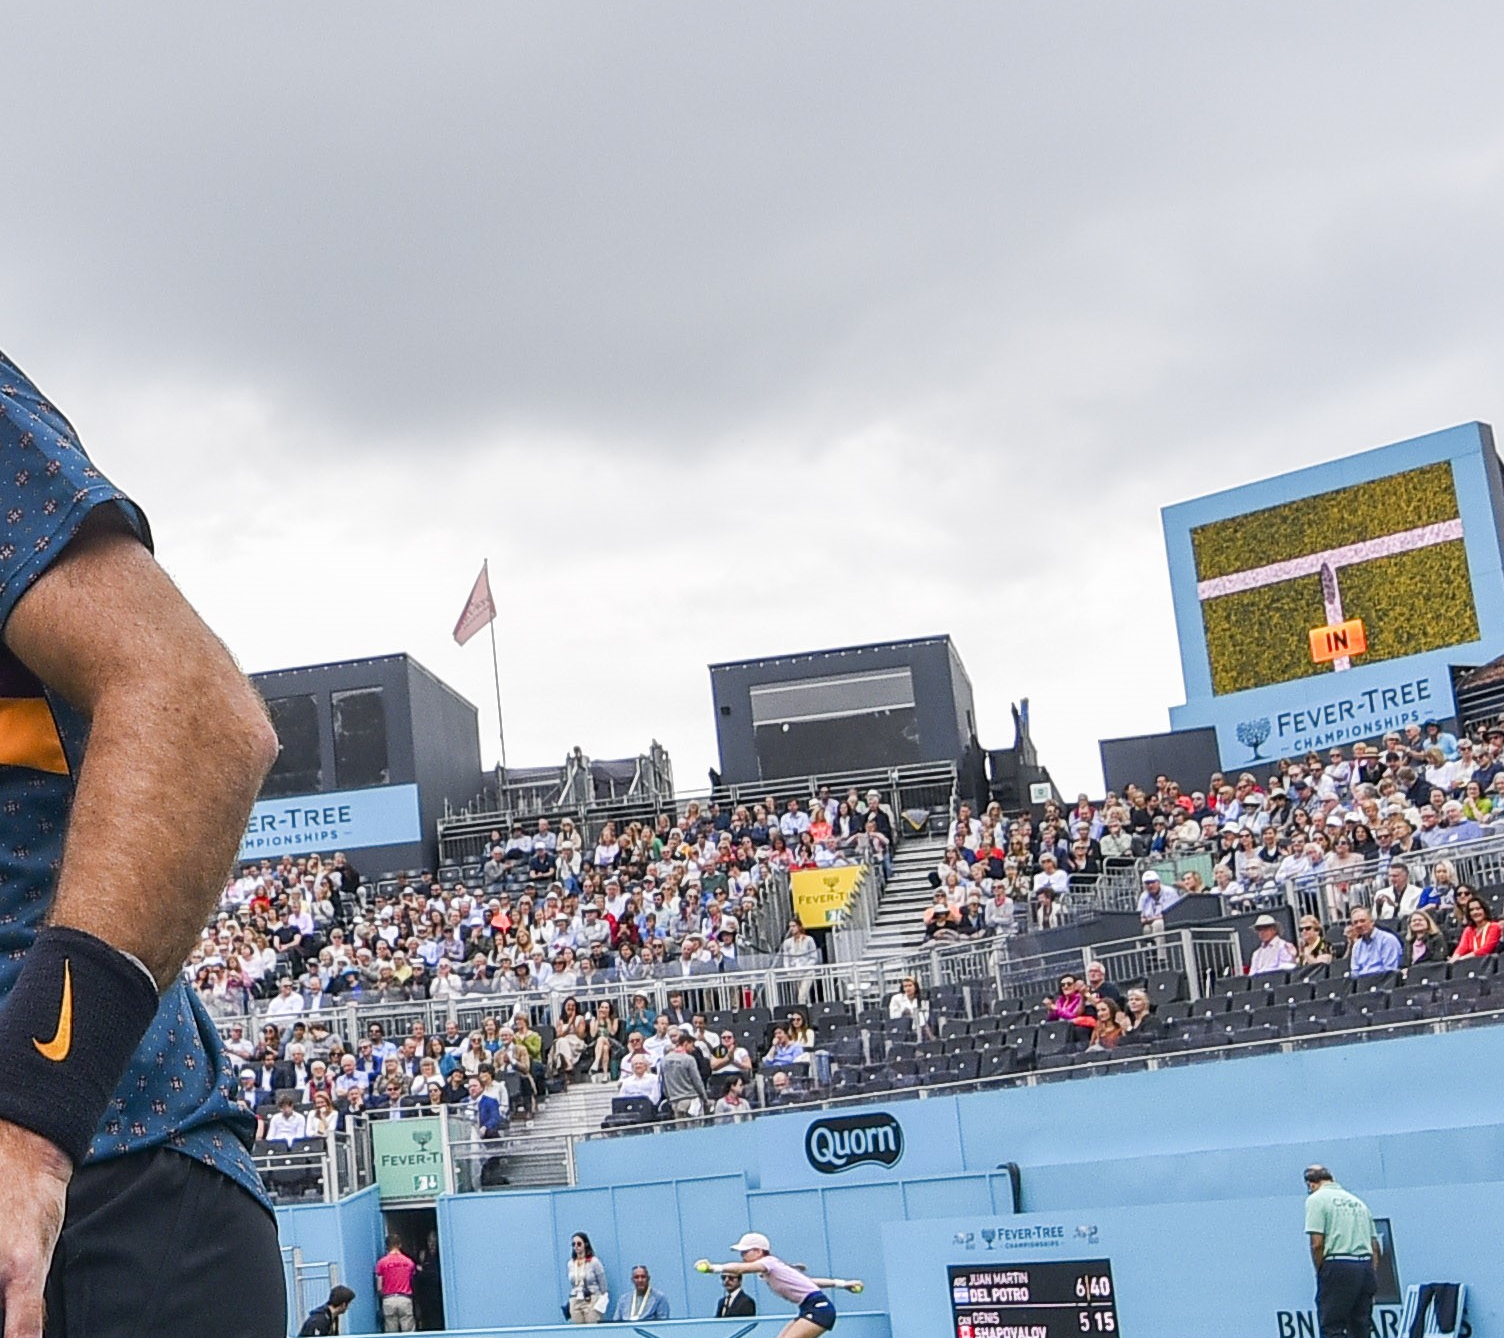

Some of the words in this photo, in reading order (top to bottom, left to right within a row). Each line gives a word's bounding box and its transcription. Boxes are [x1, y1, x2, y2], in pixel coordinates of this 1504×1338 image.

[1326, 630, 1349, 653] IN
[1277, 678, 1432, 738] FEVER-TREE
[1294, 710, 1420, 752] CHAMPIONSHIPS
[798, 891, 850, 905] FEVER-T
[811, 1125, 897, 1166] Quorn
[997, 1225, 1065, 1241] FEVER-TREE
[969, 1273, 992, 1286] JUAN
[993, 1271, 1029, 1285] MARTIN
[1075, 1278, 1085, 1297] 6
[1090, 1277, 1111, 1296] 40
[970, 1287, 991, 1303] DEL
[992, 1286, 1030, 1303] POTRO
[972, 1311, 1000, 1325] DENIS
[1079, 1312, 1090, 1332] 5
[1094, 1312, 1115, 1332] 15
